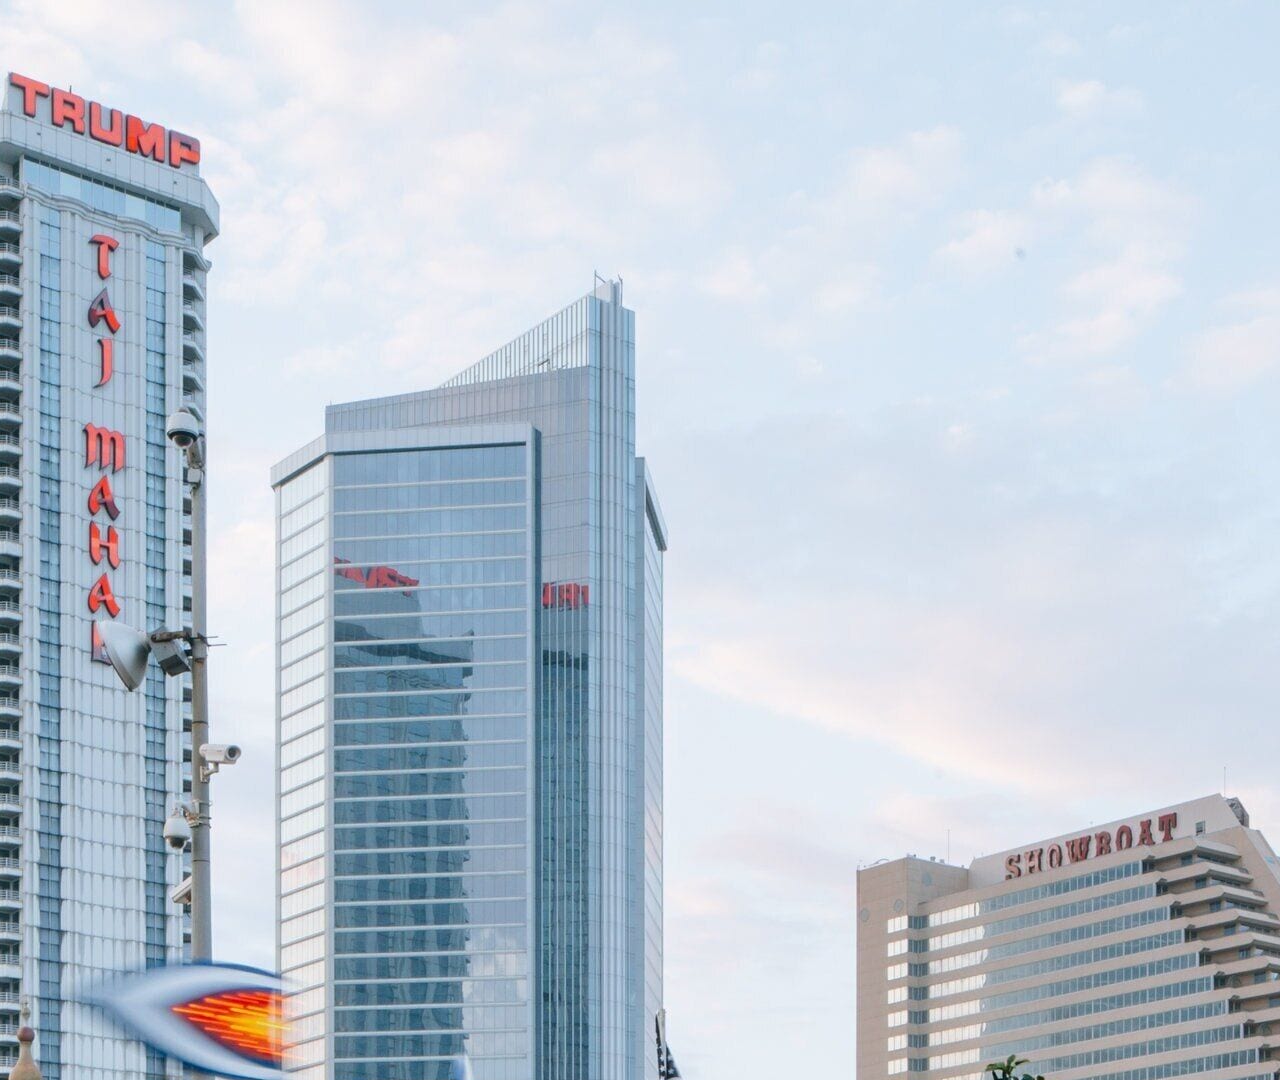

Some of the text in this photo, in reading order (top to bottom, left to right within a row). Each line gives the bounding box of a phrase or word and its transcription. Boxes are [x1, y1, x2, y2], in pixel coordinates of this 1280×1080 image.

[9, 72, 200, 169] TRUMP
[87, 234, 120, 388] TAJ
[1005, 812, 1178, 880] SHOWBOAT
